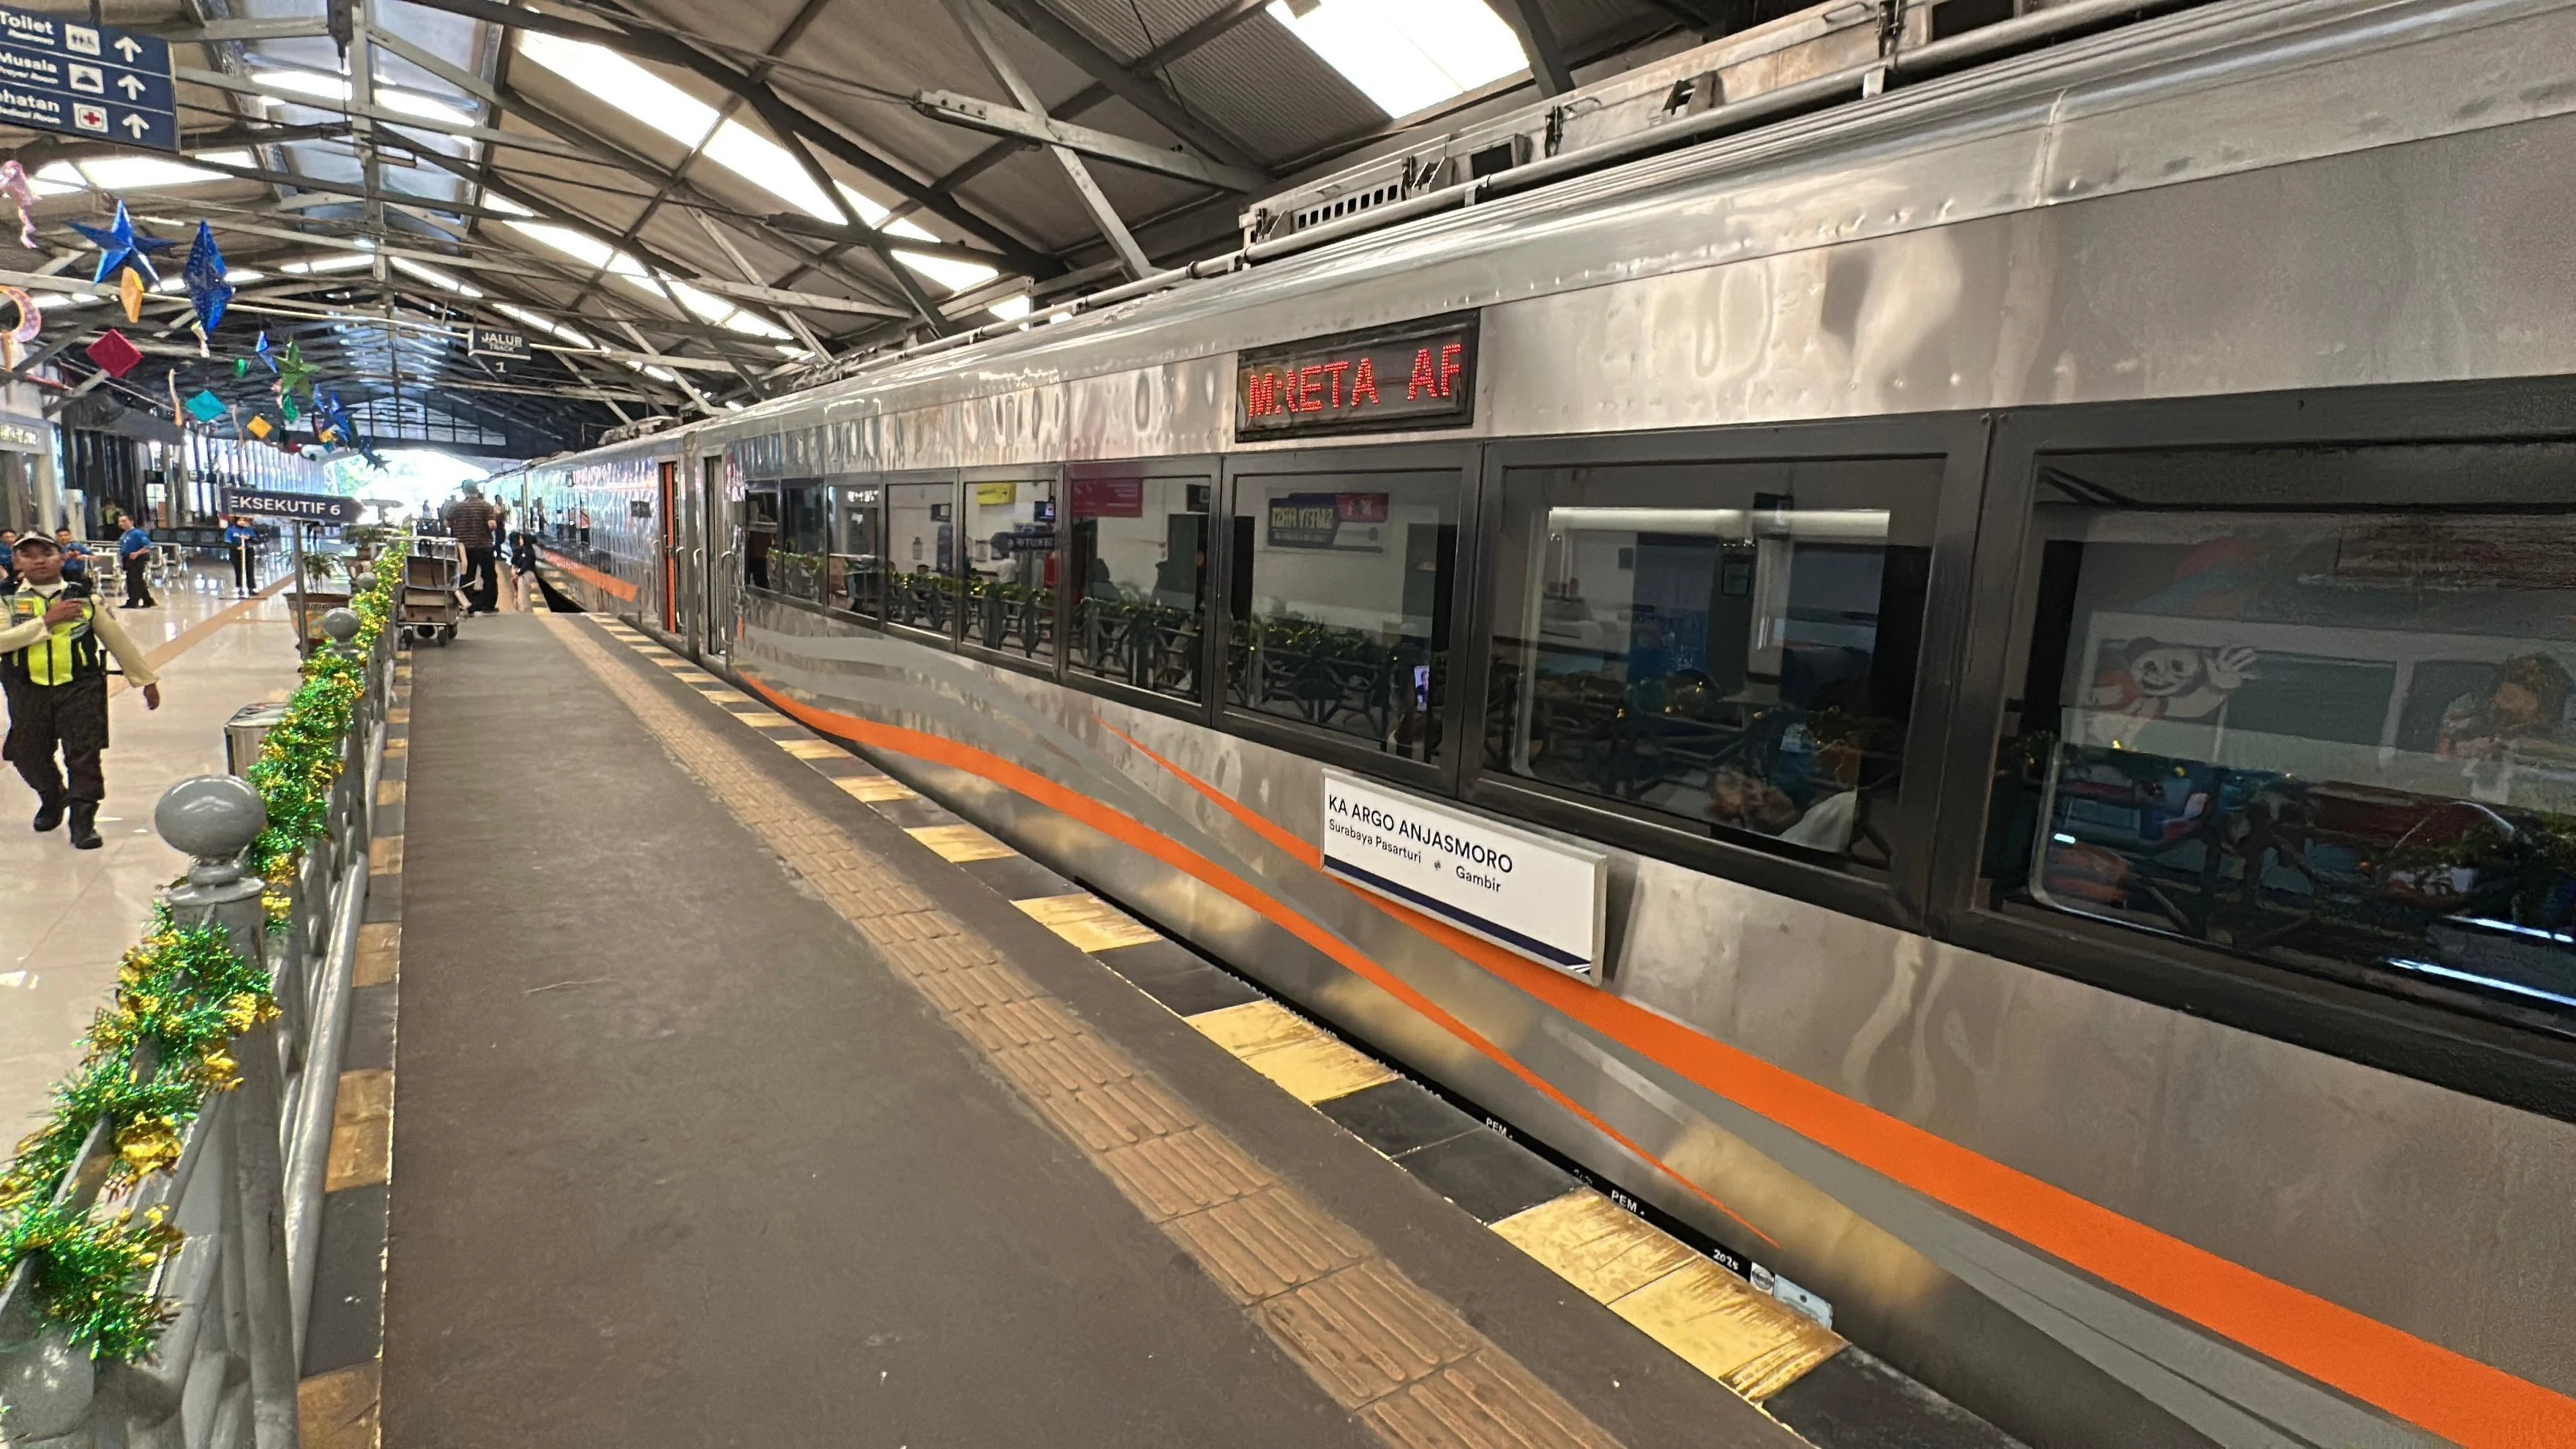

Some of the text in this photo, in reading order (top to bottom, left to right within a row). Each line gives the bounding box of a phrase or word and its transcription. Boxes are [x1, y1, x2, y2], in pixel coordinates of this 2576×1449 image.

[0, 10, 54, 35] Toilet
[0, 51, 57, 73] Musala
[481, 332, 523, 348] JALUR
[495, 362, 506, 373] 1
[231, 495, 341, 516] EKSEKUTIF 6
[1329, 794, 1513, 873] KA ARGO ANJASMORO
[1329, 819, 1501, 892] Surabaya Pasarturi Gambir
